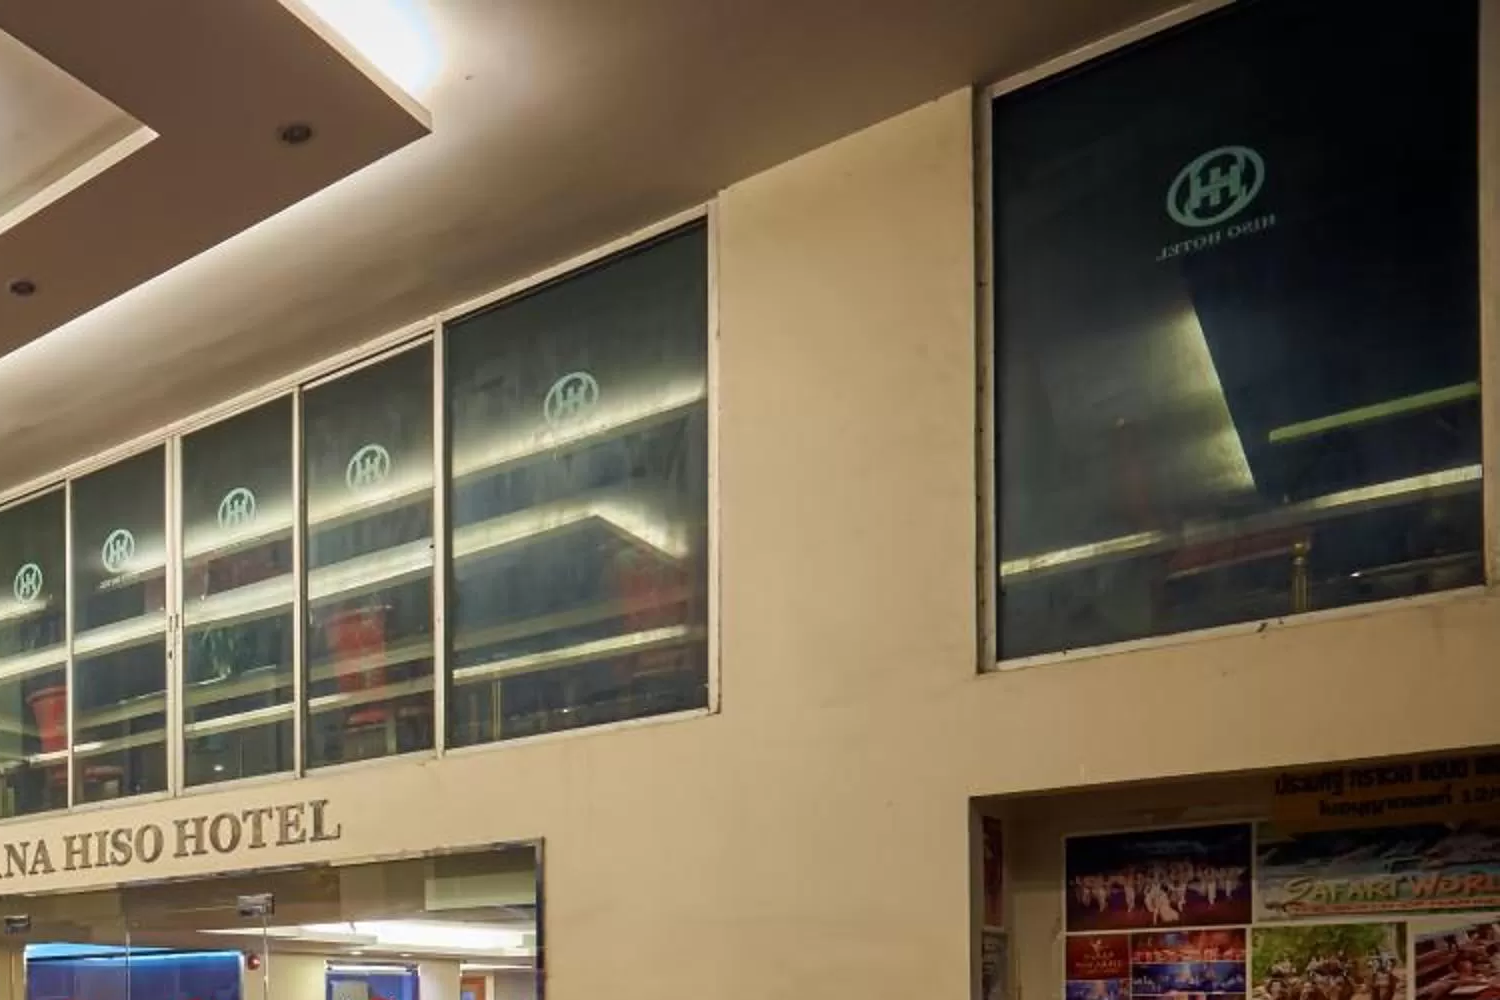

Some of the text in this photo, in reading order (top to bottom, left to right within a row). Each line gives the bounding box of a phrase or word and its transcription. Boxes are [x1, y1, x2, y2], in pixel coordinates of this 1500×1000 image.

[62, 824, 164, 871] HISO
[173, 799, 341, 858] HOTEL
[1285, 876, 1398, 901] SAFARI
